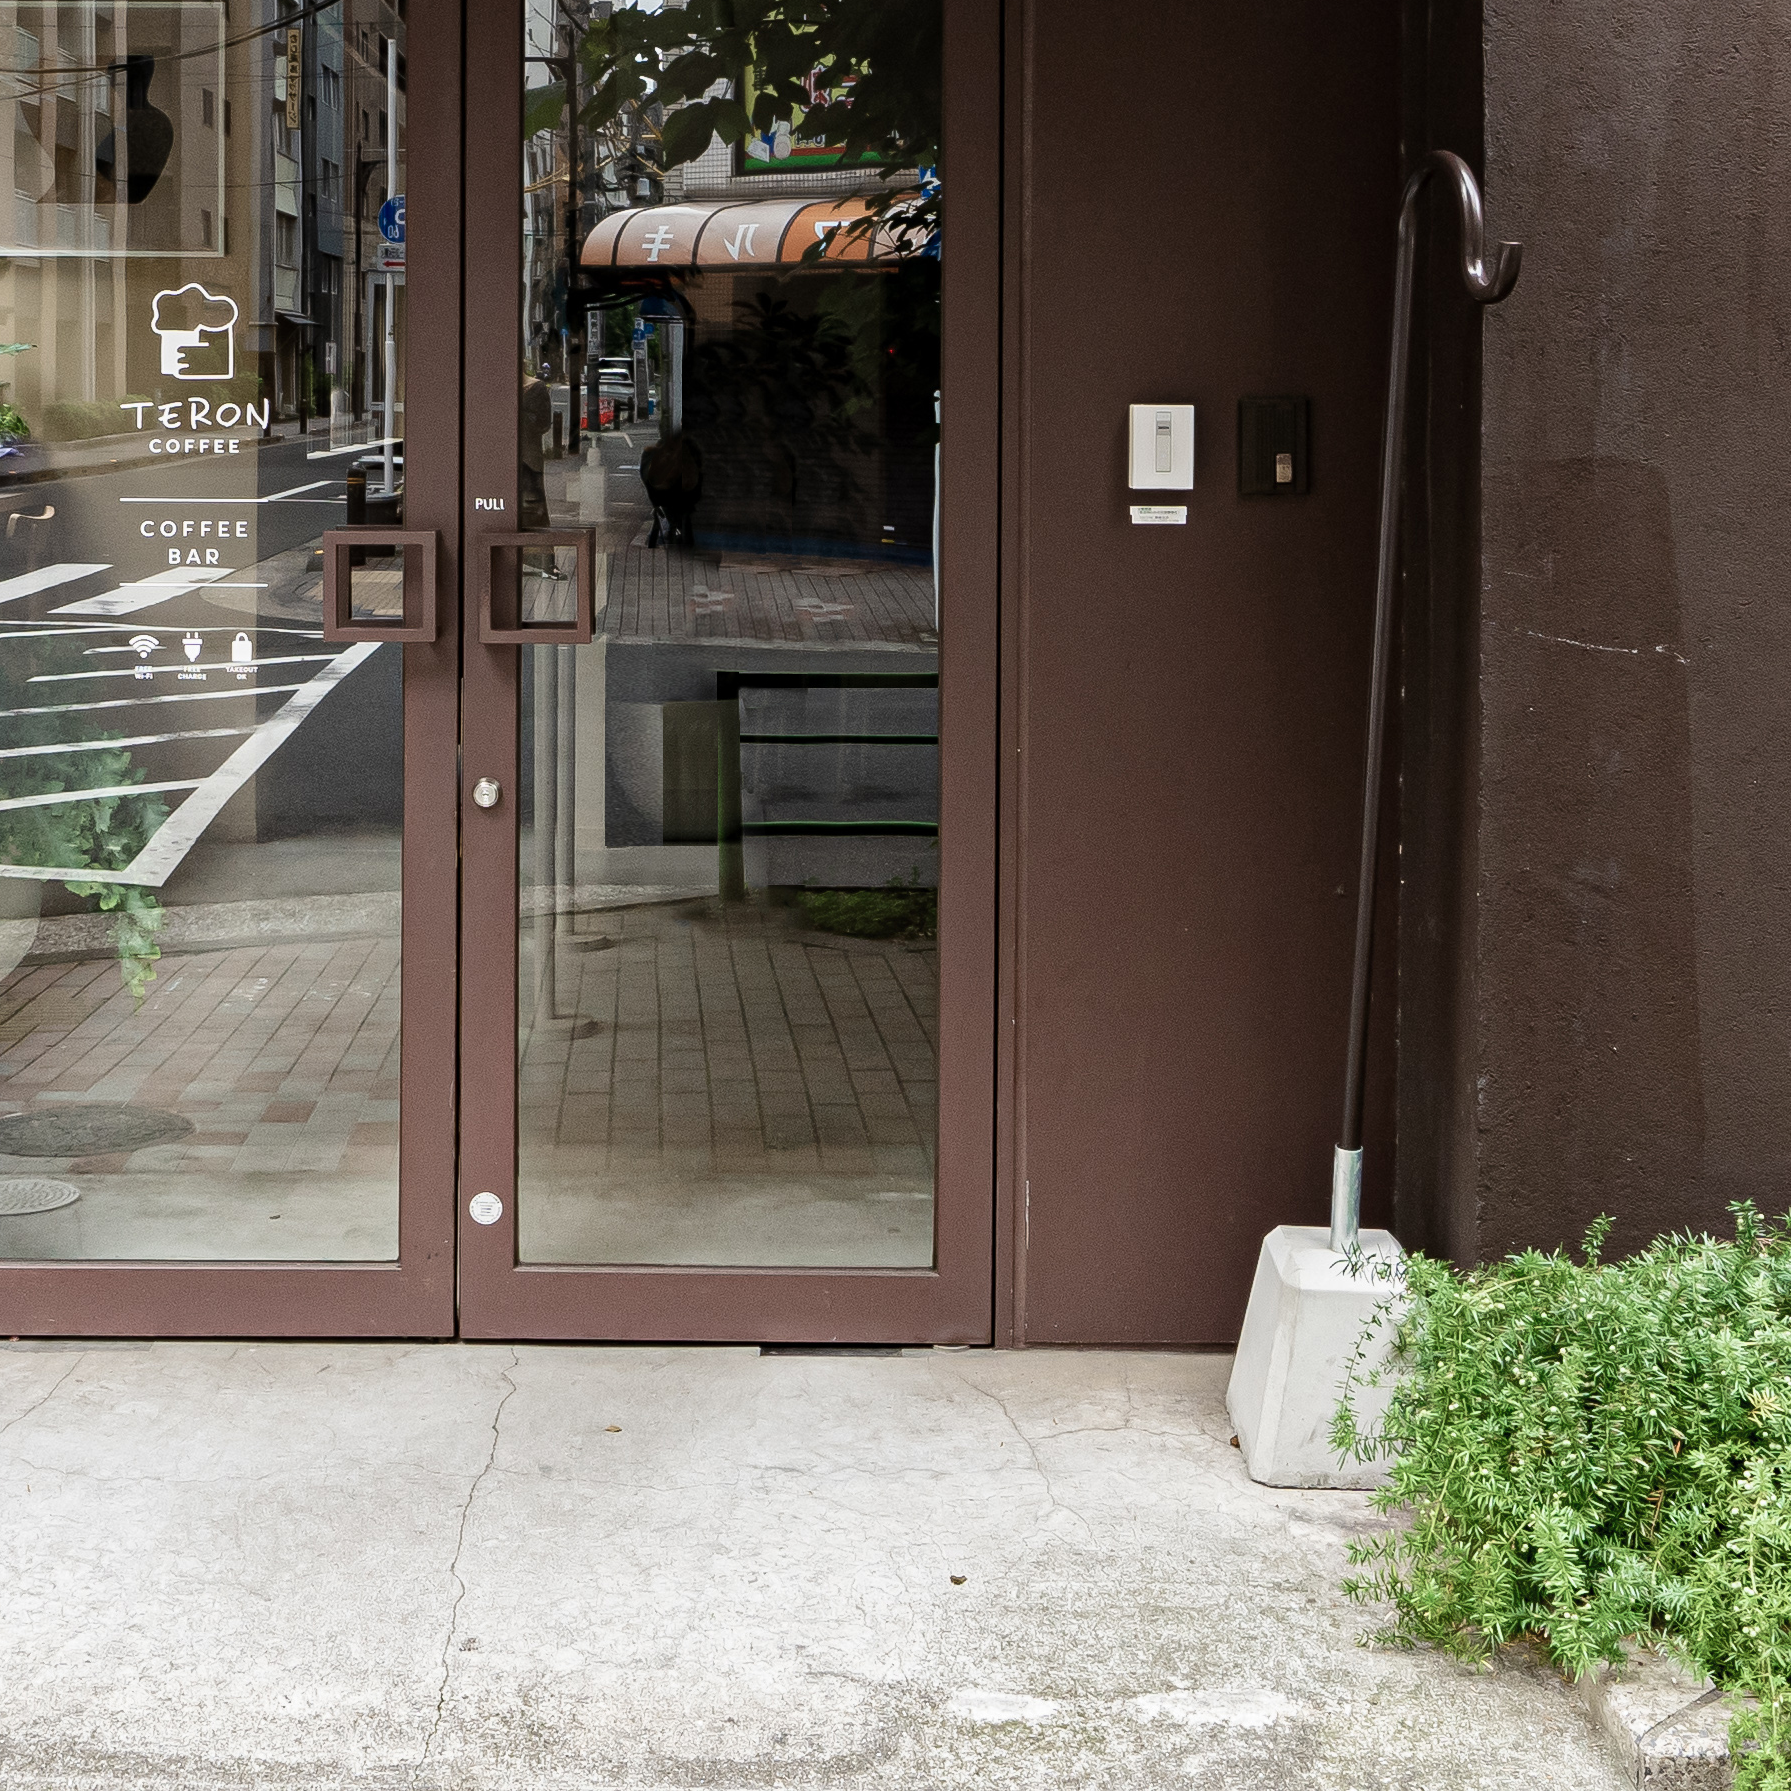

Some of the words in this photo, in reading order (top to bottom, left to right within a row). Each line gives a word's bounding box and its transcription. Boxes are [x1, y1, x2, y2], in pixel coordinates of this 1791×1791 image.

[120, 397, 270, 430] TERON
[149, 439, 240, 454] COFFEE
[140, 520, 248, 537] COFFEE
[168, 548, 220, 565] BAR
